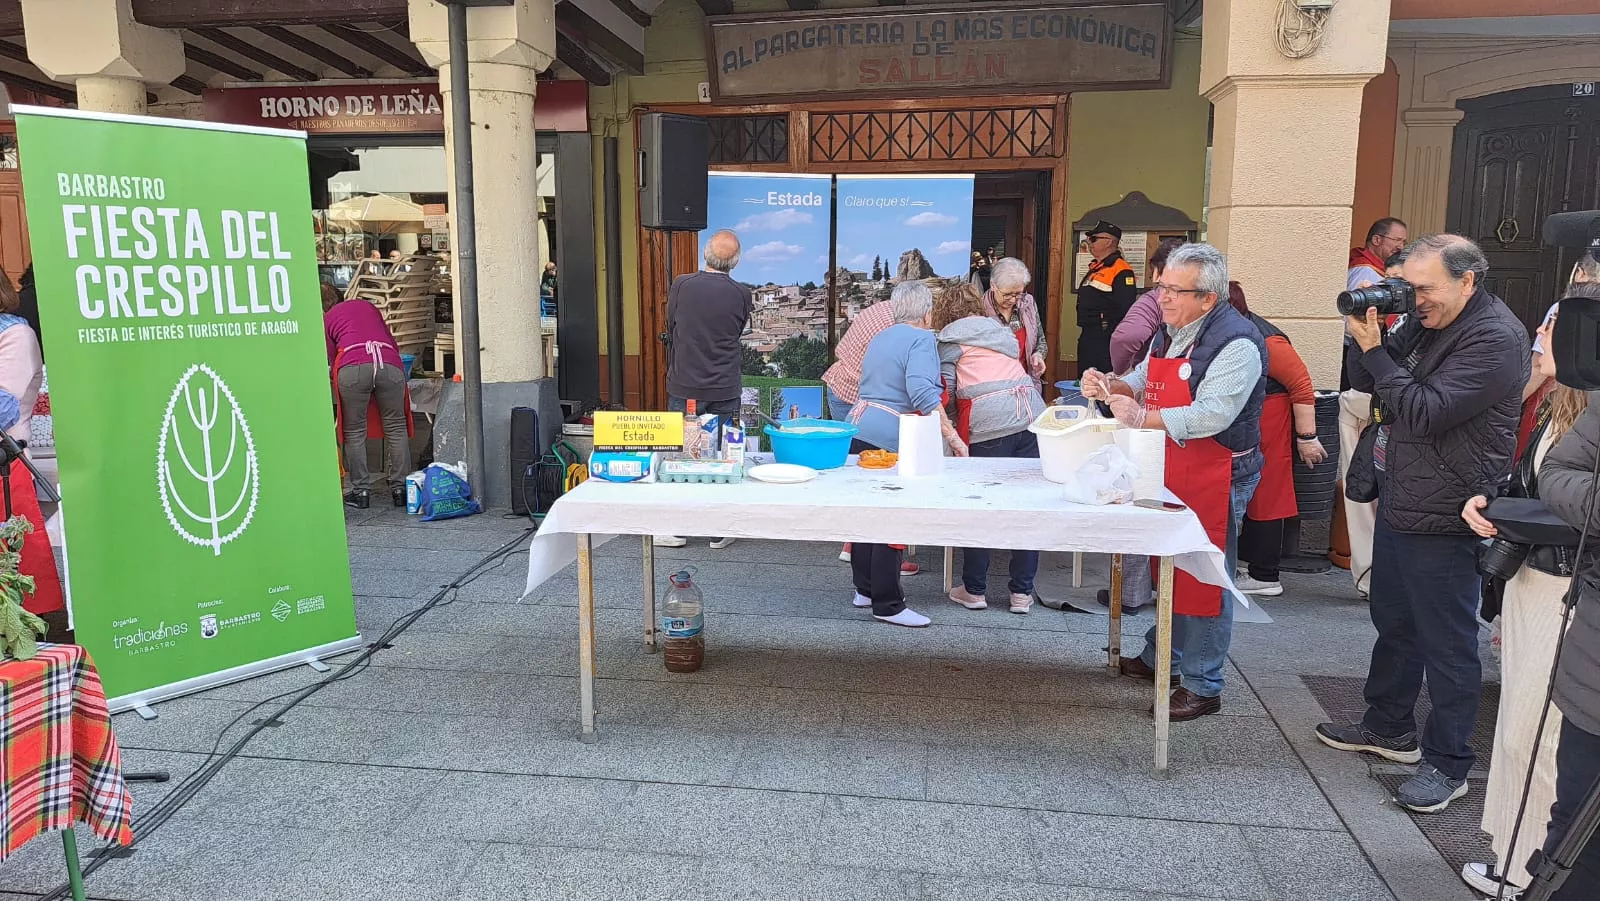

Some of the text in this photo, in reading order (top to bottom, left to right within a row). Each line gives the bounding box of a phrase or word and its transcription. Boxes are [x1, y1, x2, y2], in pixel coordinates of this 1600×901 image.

[722, 20, 905, 74] ALPARGATERIA
[915, 19, 947, 41] LA
[1011, 14, 1157, 59] ECONÓMICA
[912, 42, 955, 57] DE
[1575, 83, 1592, 95] 20
[260, 88, 442, 118] HORNO DE LEÑA
[57, 172, 165, 201] BARBASTRO
[767, 191, 823, 206] Estada
[844, 195, 874, 207] Claro
[876, 197, 898, 209] que
[62, 204, 292, 261] FIESTA DEL
[75, 264, 291, 319] CRESPILLO
[78, 319, 299, 344] FIESTA DE INTERÉS TURÍSTICO DE ARAGÓN
[623, 430, 655, 441] Estada
[220, 612, 261, 625] BARBASTRO
[128, 640, 176, 656] BARBASTRO
